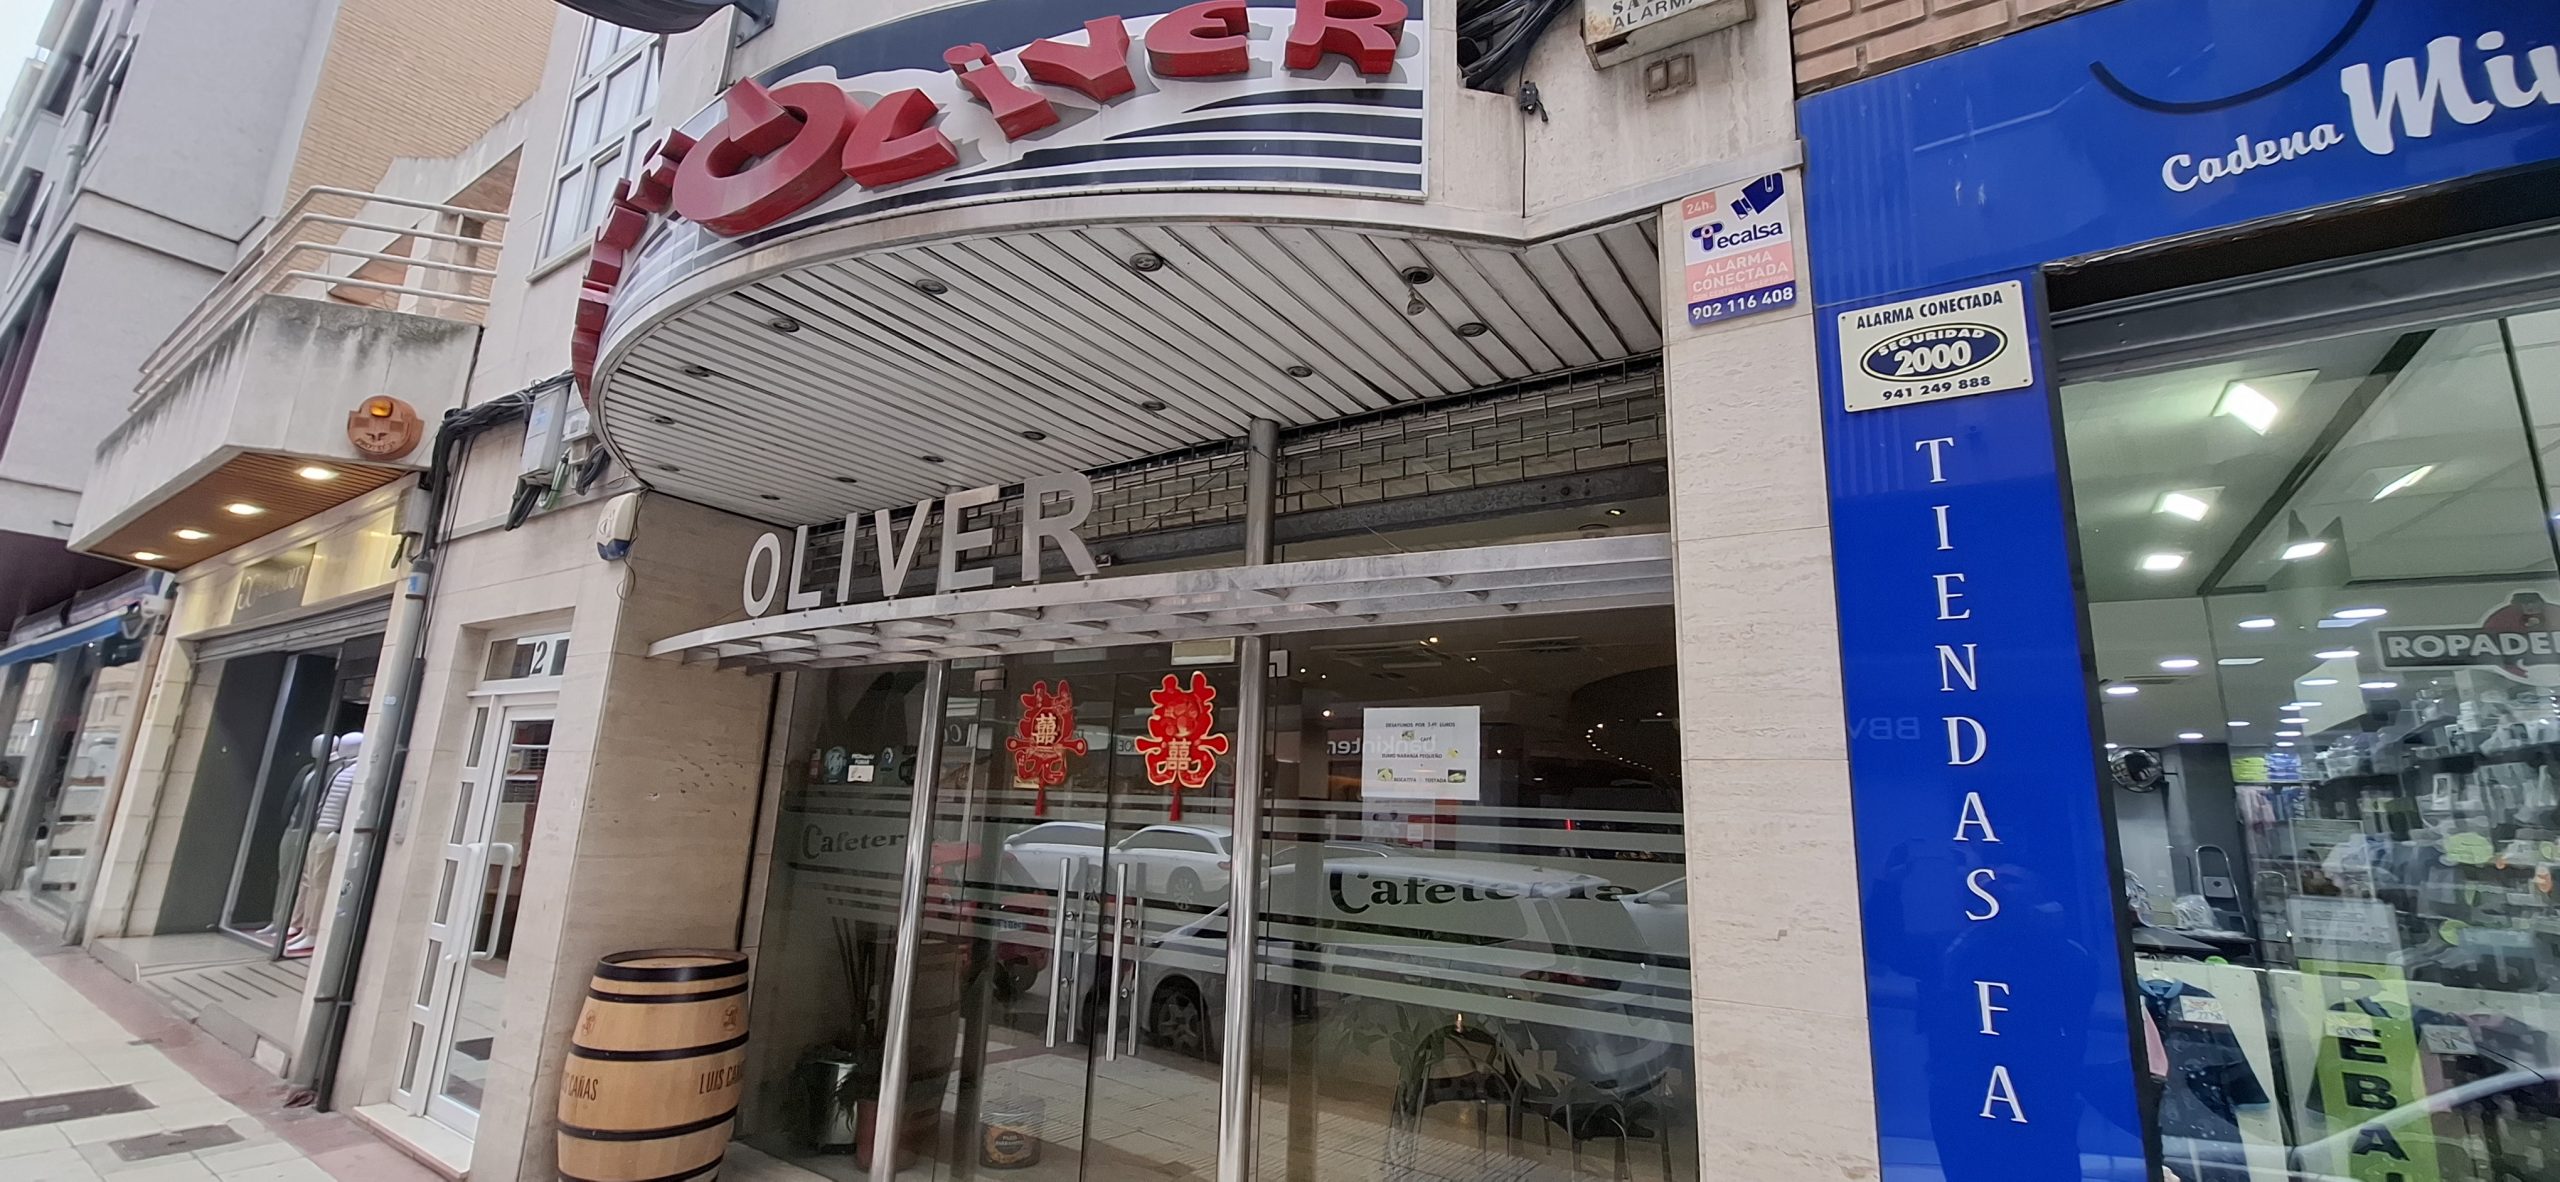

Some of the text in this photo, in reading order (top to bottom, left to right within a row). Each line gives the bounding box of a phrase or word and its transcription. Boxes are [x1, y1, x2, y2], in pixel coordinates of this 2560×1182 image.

[1612, 0, 1698, 31] ALARM
[2161, 123, 2345, 192] Cadena
[1691, 221, 1783, 251] Tecalsa
[1692, 262, 1789, 293] CONECTADA
[1705, 251, 1773, 277] ALARMA
[1692, 287, 1793, 320] 902 116 408
[1857, 290, 2003, 329] ALARMA CONECTADA
[1878, 328, 1986, 356] SEGURIDAD
[1893, 340, 1972, 377] 2000
[1883, 376, 1991, 401] 941 249 888
[743, 471, 1099, 617] OLIVER
[531, 640, 548, 674] 2
[1915, 436, 2001, 921] TIENDAS
[802, 823, 905, 859] Cafeter
[567, 1073, 599, 1101] CAÑAS
[699, 1068, 725, 1095] LUIS
[2319, 971, 2410, 1182] REBA
